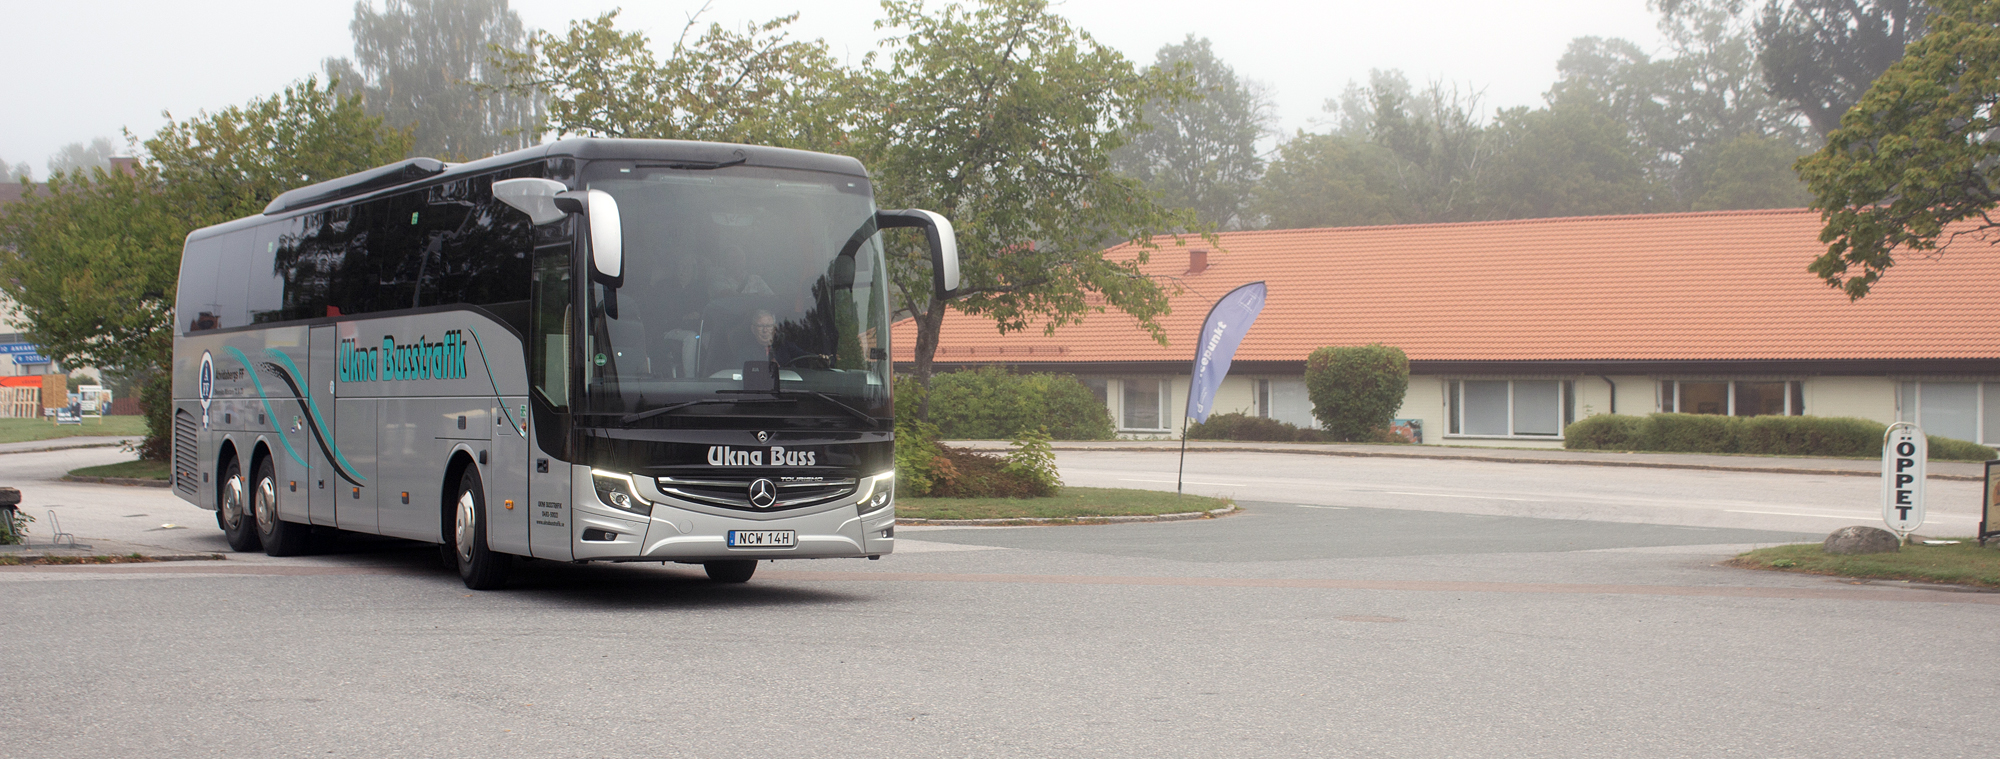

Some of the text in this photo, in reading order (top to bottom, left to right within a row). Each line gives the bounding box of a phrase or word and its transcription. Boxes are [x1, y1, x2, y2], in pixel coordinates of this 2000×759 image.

[340, 329, 467, 382] Ukna Busstrafik
[707, 446, 816, 466] Ukna Buss
[1895, 437, 1916, 521] ÖPPET
[739, 532, 790, 545] NCW 14H
